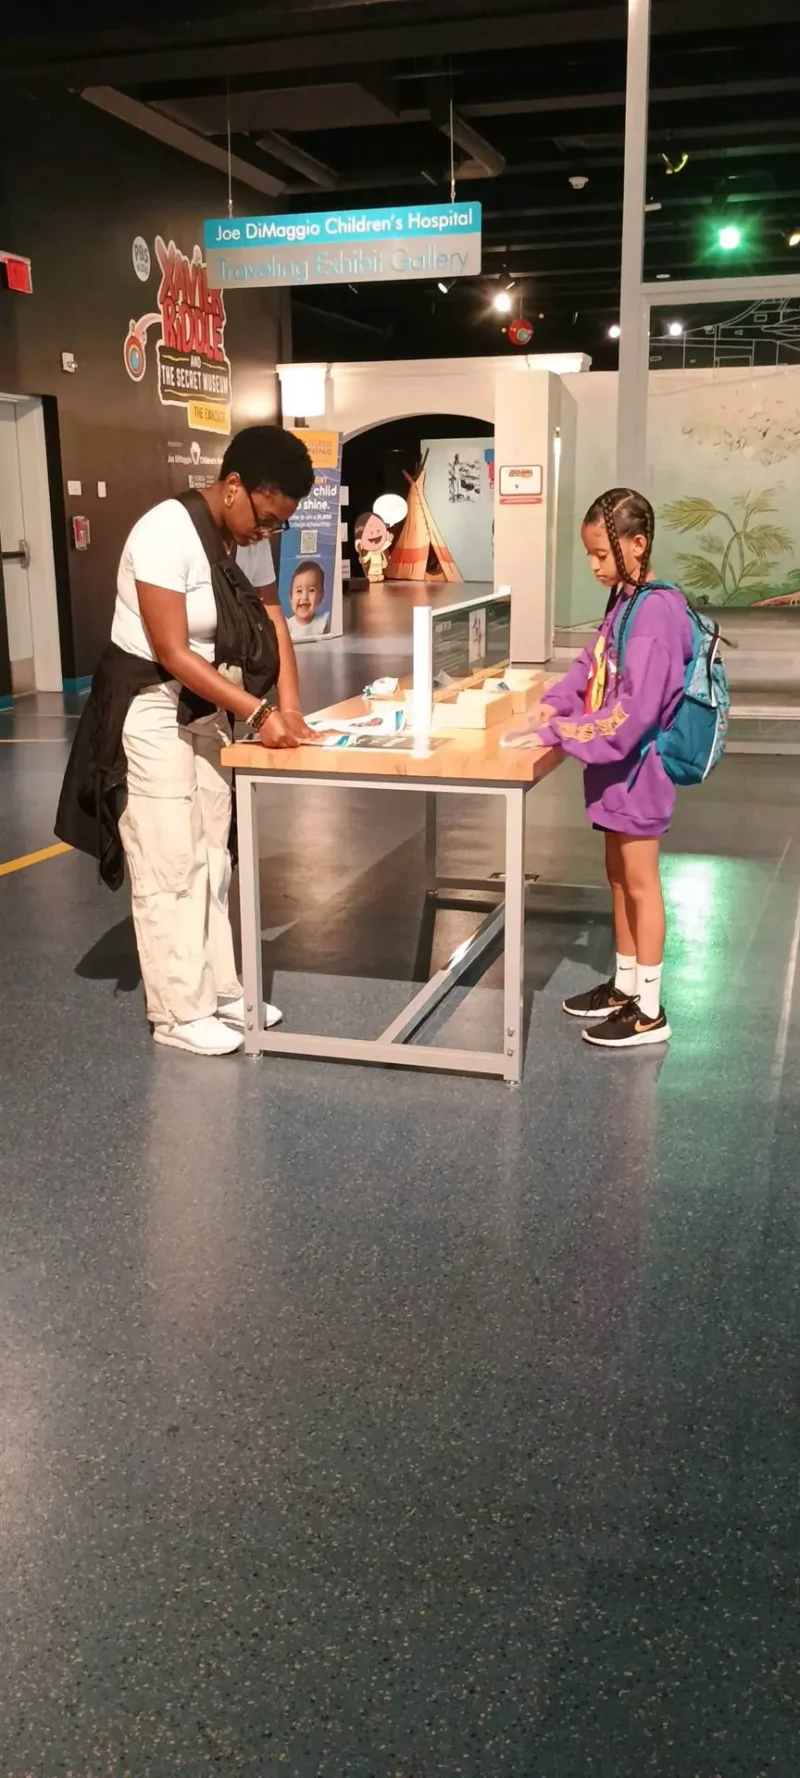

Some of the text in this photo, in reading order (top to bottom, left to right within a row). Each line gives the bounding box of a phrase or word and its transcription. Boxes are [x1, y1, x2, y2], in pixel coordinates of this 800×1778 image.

[215, 208, 473, 241] Joe DiMaggio Children's Hospital
[134, 244, 149, 264] PBS
[216, 243, 470, 284] Traveling Exhibit Gallery
[190, 355, 202, 369] AND
[161, 364, 229, 394] THE SECRET MUSEUM
[194, 405, 204, 419] THE
[313, 485, 338, 497] child
[303, 499, 330, 510] shine.
